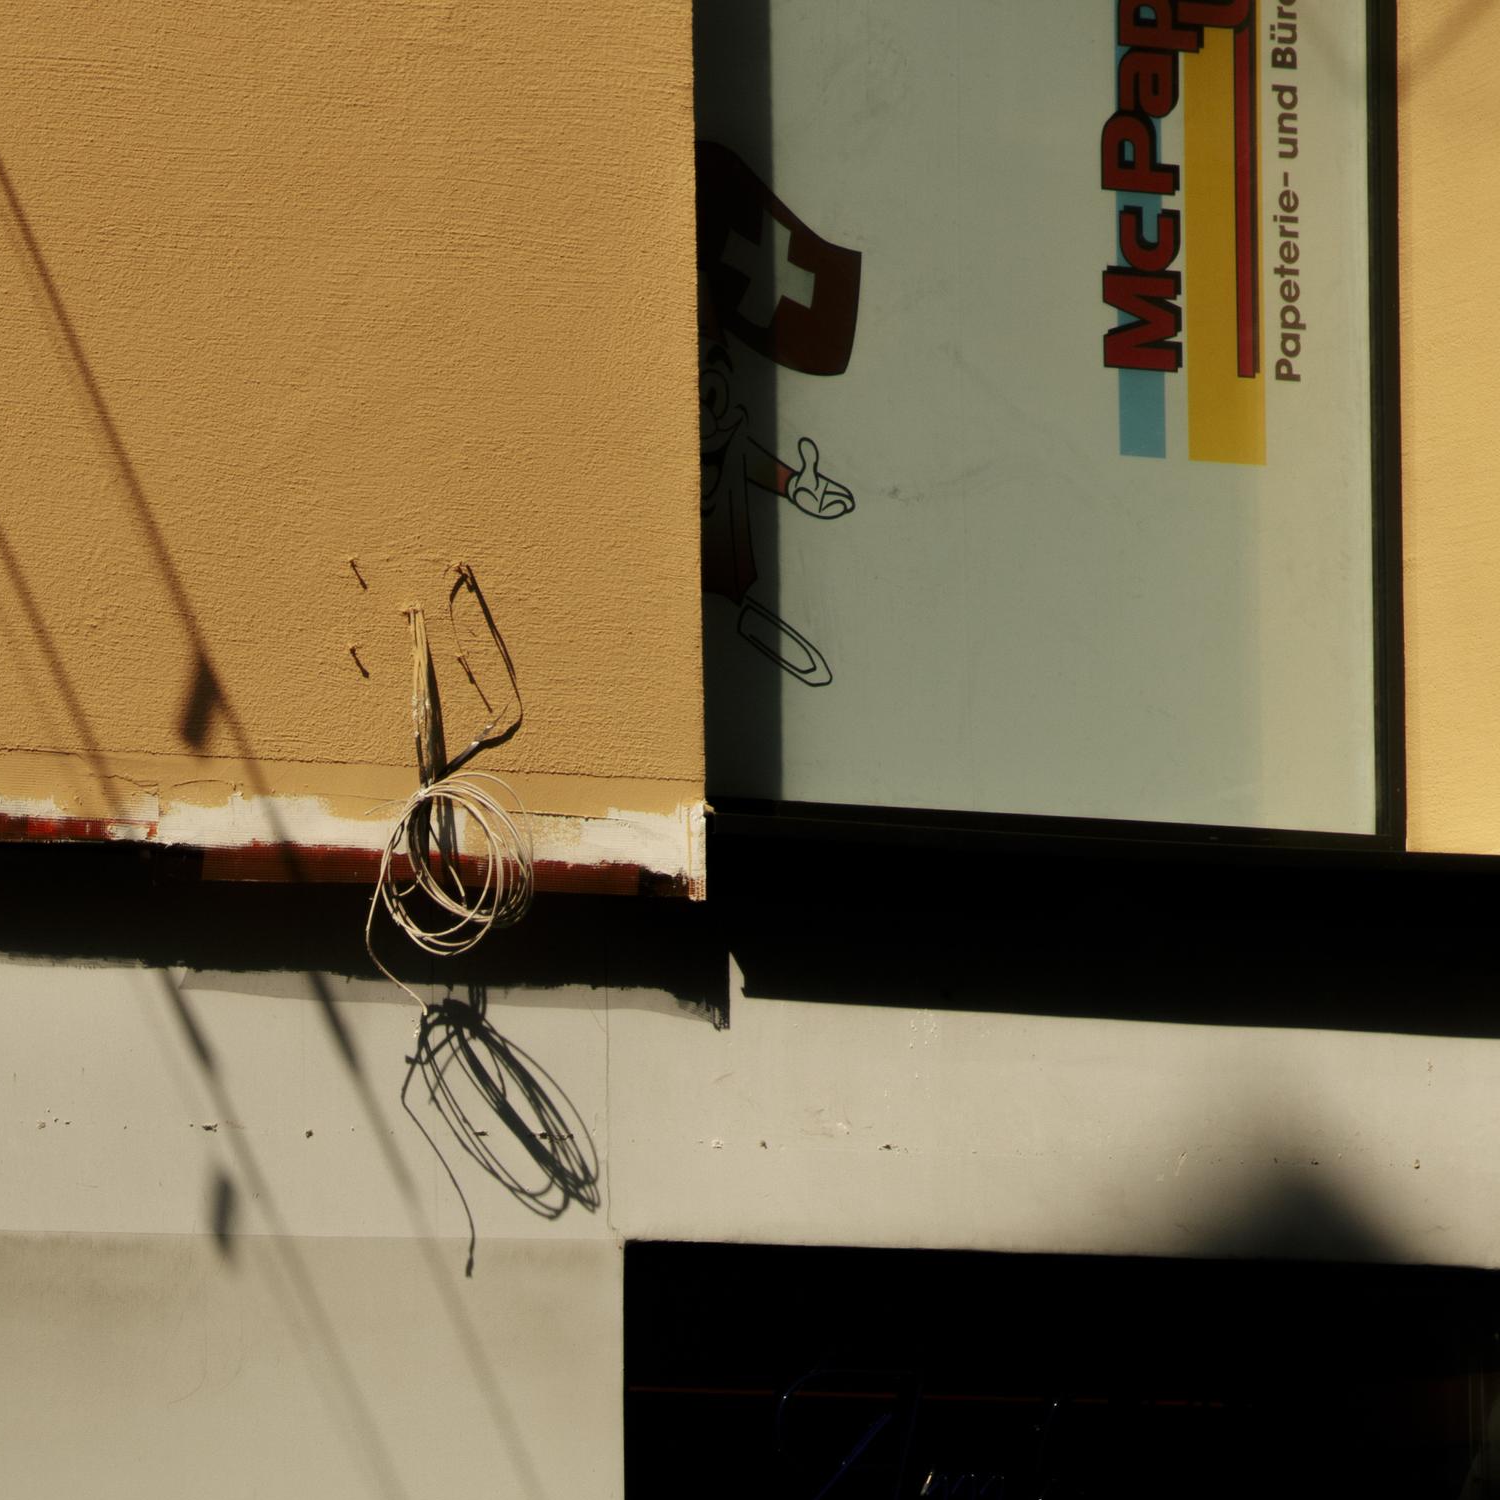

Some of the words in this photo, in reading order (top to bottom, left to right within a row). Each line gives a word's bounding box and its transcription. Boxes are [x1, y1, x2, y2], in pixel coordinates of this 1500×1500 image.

[1269, 0, 1298, 70] Bür
[1272, 84, 1299, 159] und
[1274, 171, 1307, 382] Papeterie-
